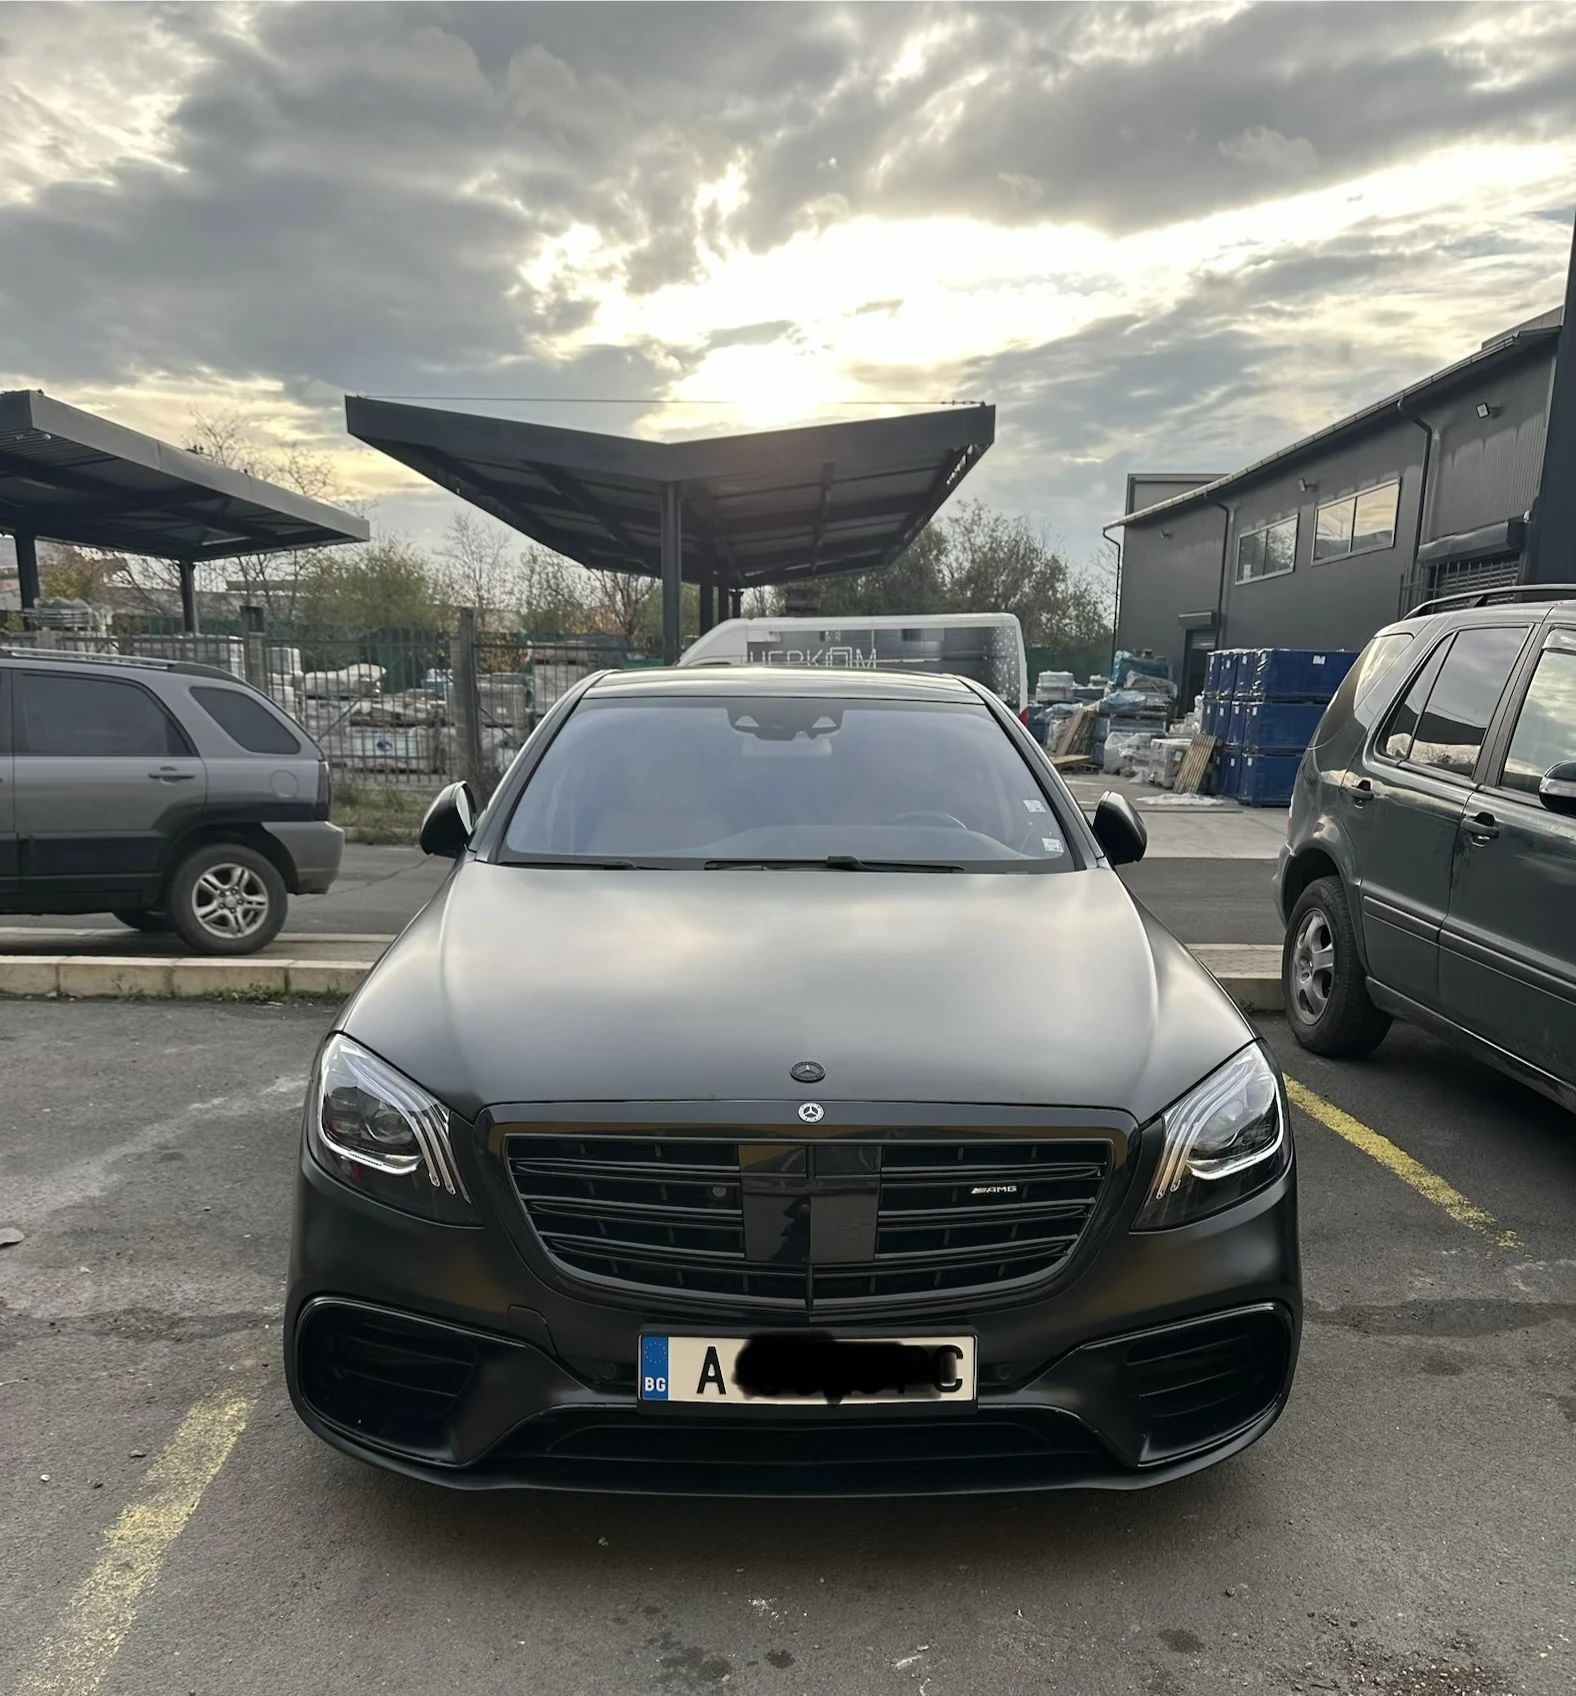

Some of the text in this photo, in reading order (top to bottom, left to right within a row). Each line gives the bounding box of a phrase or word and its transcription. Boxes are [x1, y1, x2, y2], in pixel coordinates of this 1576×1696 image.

[984, 1185, 1018, 1194] AMG
[696, 1346, 727, 1395] A
[644, 1376, 666, 1392] BG
